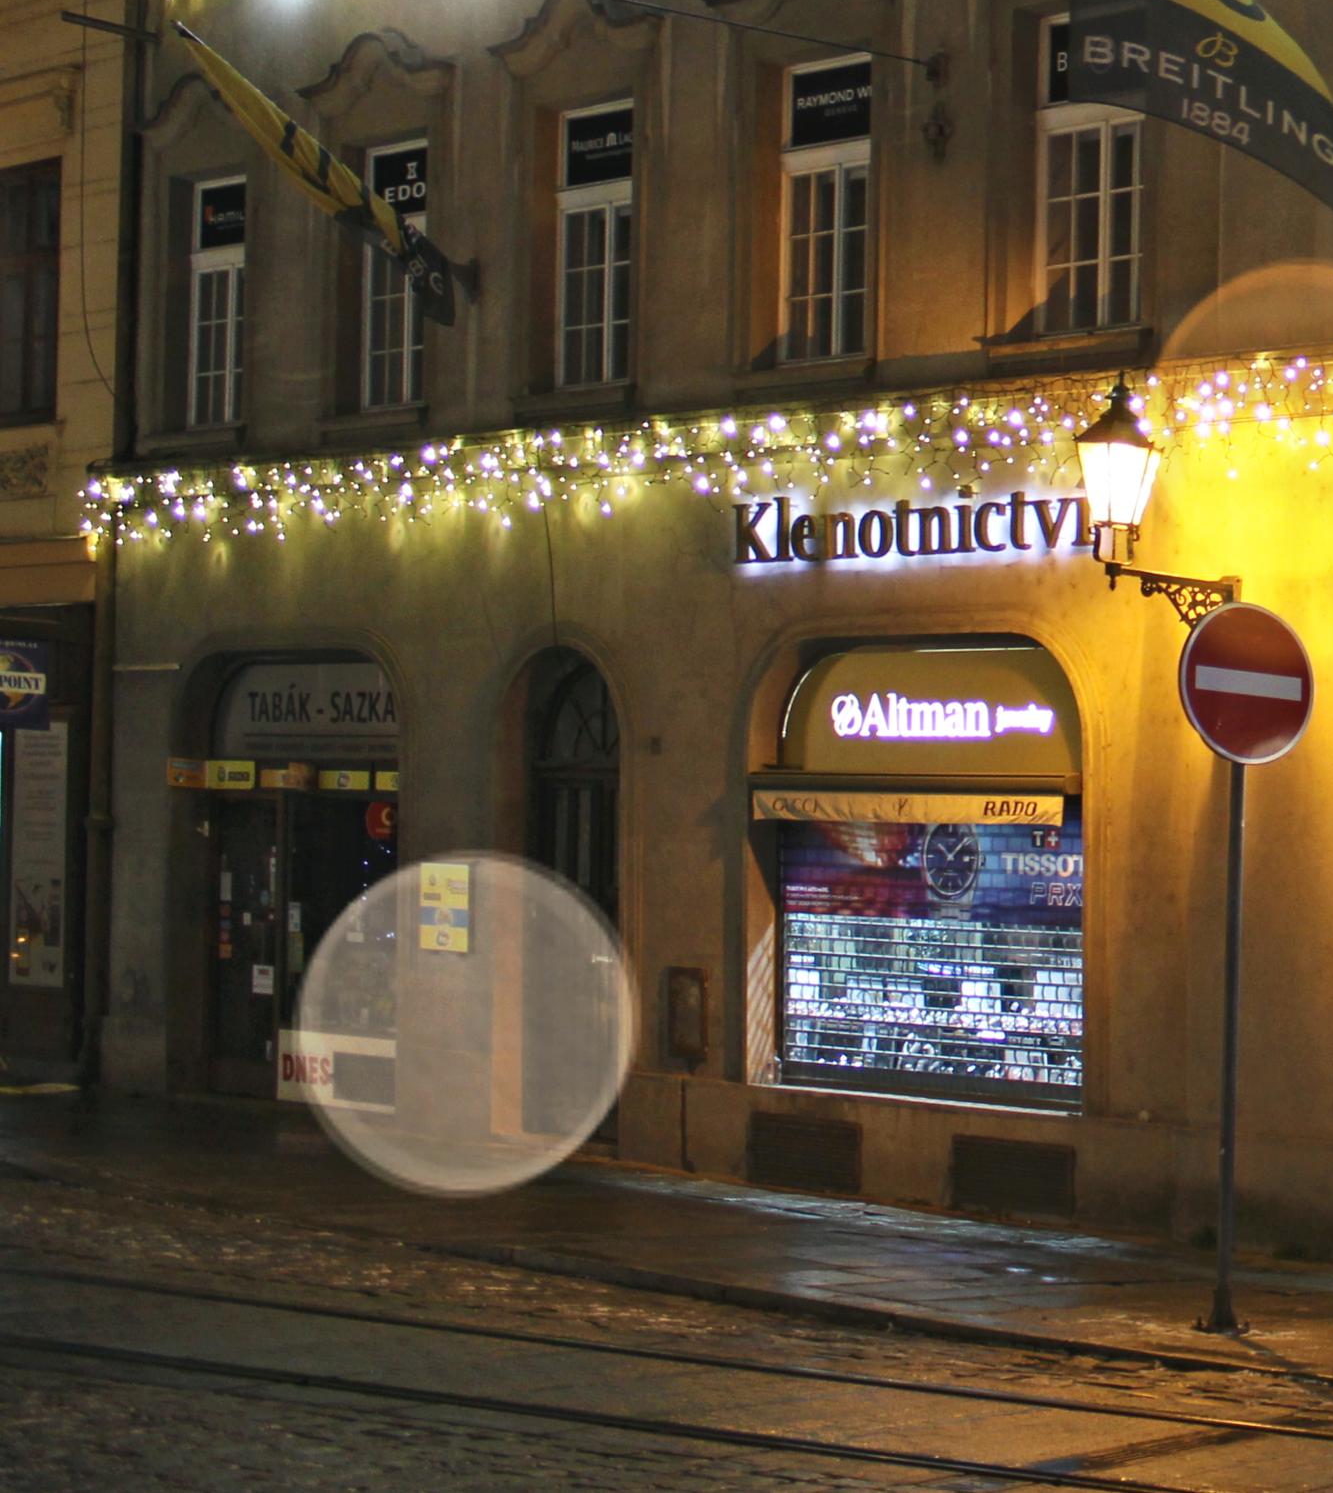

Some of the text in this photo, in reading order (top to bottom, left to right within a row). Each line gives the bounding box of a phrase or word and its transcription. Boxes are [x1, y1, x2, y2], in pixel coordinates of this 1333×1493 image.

[1181, 98, 1252, 145] 1884
[384, 181, 426, 203] EDO
[247, 682, 312, 724] TABÁK
[329, 690, 397, 724] SAZKA
[859, 692, 992, 737] Altman
[983, 800, 1038, 818] RADO
[1000, 852, 1083, 878] TISSOT
[1029, 882, 1083, 907] PRX
[281, 1052, 333, 1086] DNES
